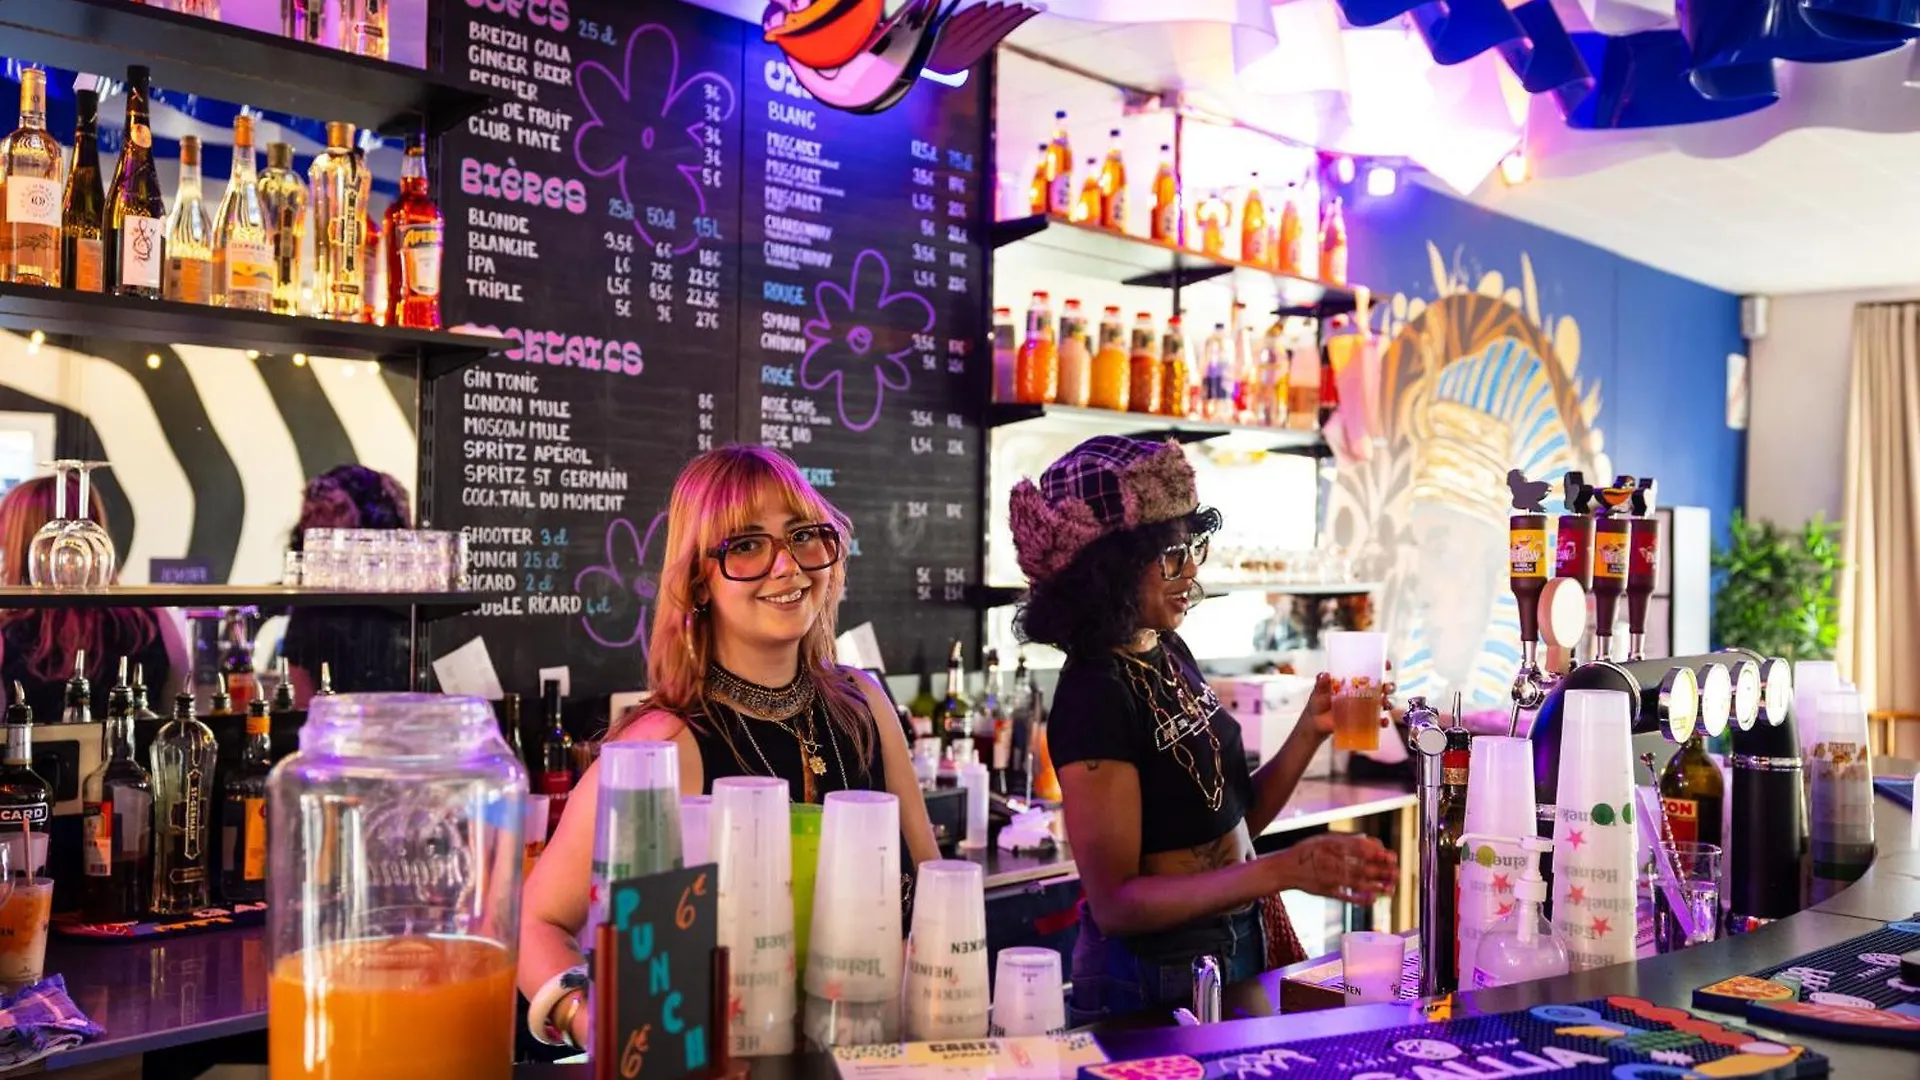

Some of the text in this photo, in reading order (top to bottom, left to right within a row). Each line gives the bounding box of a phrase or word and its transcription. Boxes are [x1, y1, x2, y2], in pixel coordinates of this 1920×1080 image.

[469, 21, 571, 63] BREIZH COLA
[469, 44, 572, 86] GINGER BEER
[503, 103, 523, 120] DE
[528, 108, 572, 131] FRUIT
[768, 100, 817, 131] BLANC
[468, 116, 561, 152] CLUB MATÉ
[468, 207, 530, 234] BLONDE
[468, 231, 539, 258] BLANCHE
[468, 250, 496, 274] IPA
[466, 277, 524, 302] TRIPLE
[464, 366, 539, 393] GIN TONIC
[464, 394, 522, 415] LONDON
[530, 400, 571, 419] MULE
[464, 417, 525, 438] MOSCOW
[530, 423, 571, 442] MULE
[464, 438, 527, 461] SPRITZ
[534, 442, 593, 465] APÉROL
[464, 463, 628, 490] SPRITZ ST GERMAIN
[462, 486, 625, 512] COCKTAIL DU MOMENT
[461, 526, 533, 546] SHOOTER
[540, 528, 551, 546] 3
[466, 551, 518, 569] PUNCH
[524, 551, 542, 569] 25
[525, 573, 535, 592] 2
[528, 592, 582, 615] RICARD
[615, 888, 707, 1070] PUNCH
[1352, 1046, 1609, 1080] ALLIA
